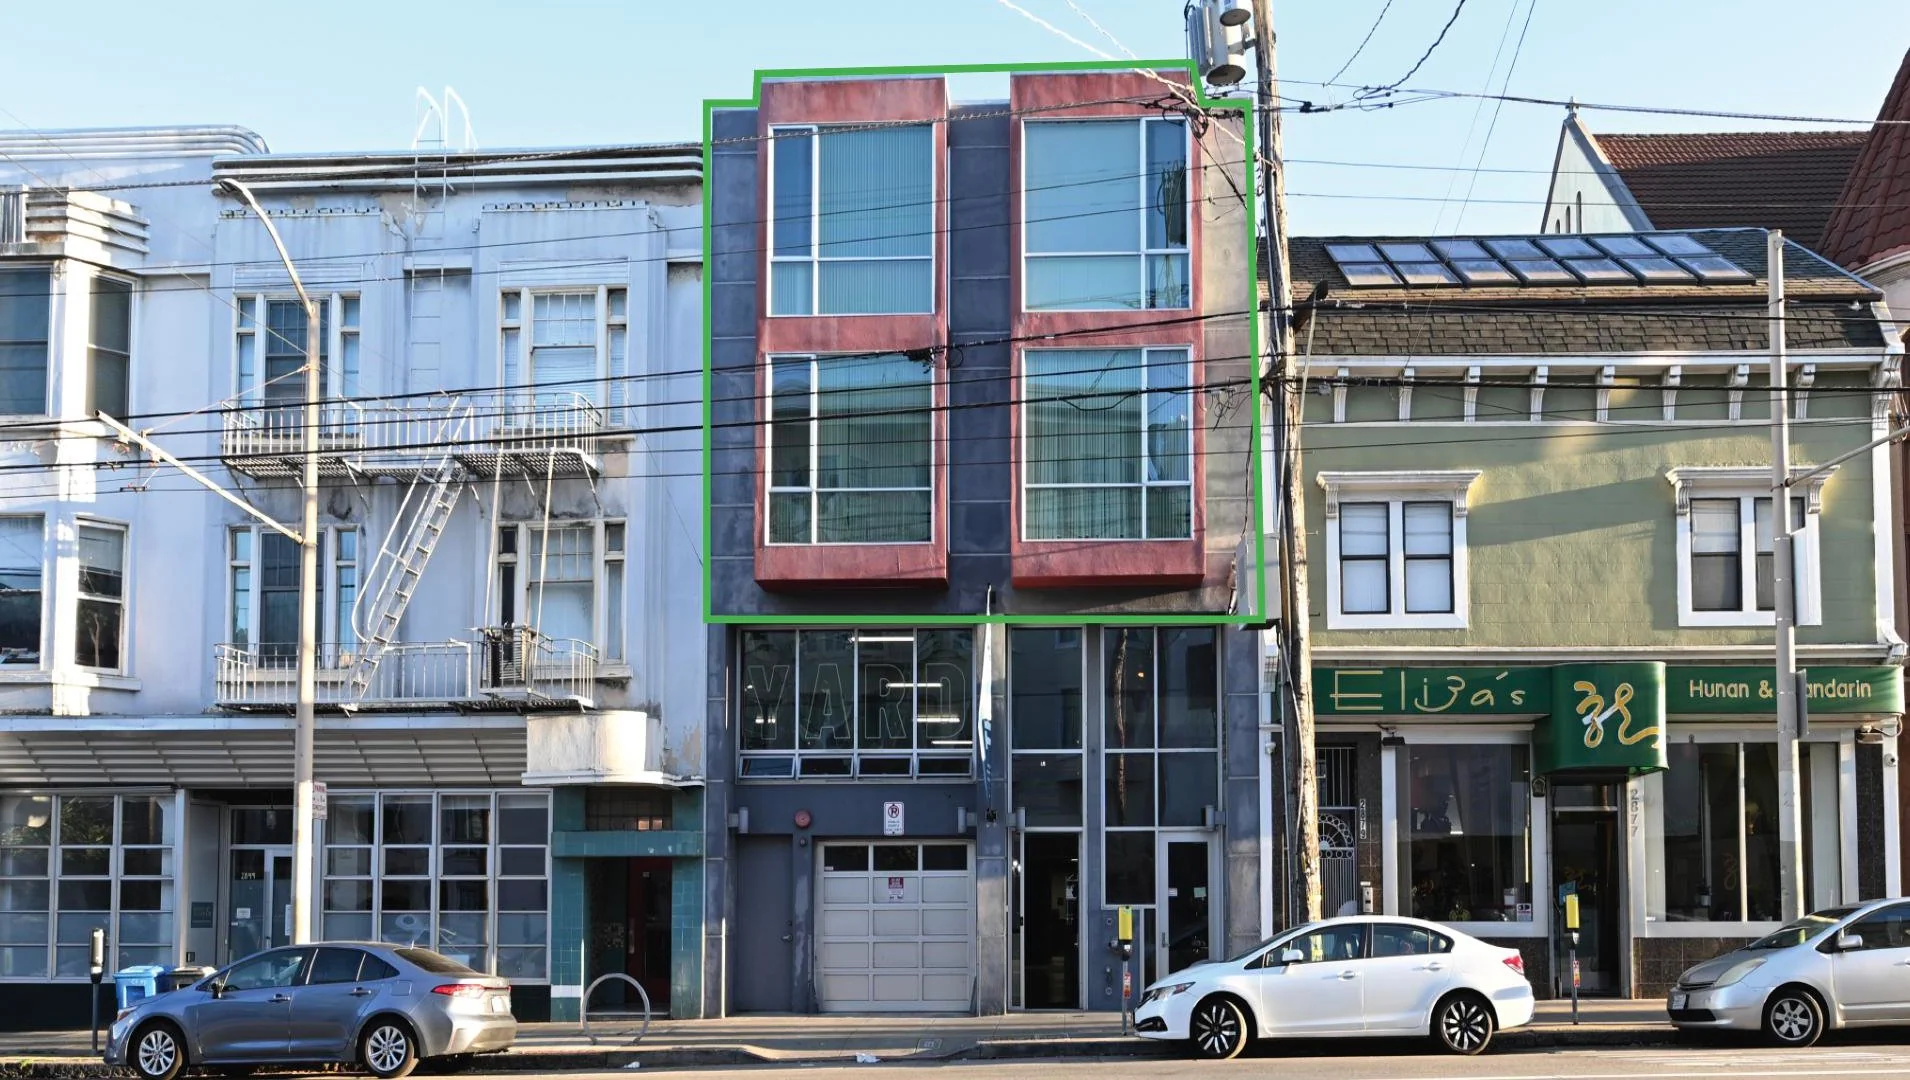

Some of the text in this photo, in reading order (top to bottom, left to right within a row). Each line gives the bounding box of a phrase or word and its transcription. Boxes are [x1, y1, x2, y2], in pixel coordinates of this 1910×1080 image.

[747, 663, 966, 740] YARD
[1689, 677, 1872, 699] Hunan & andarin
[1630, 788, 1640, 838] 2877
